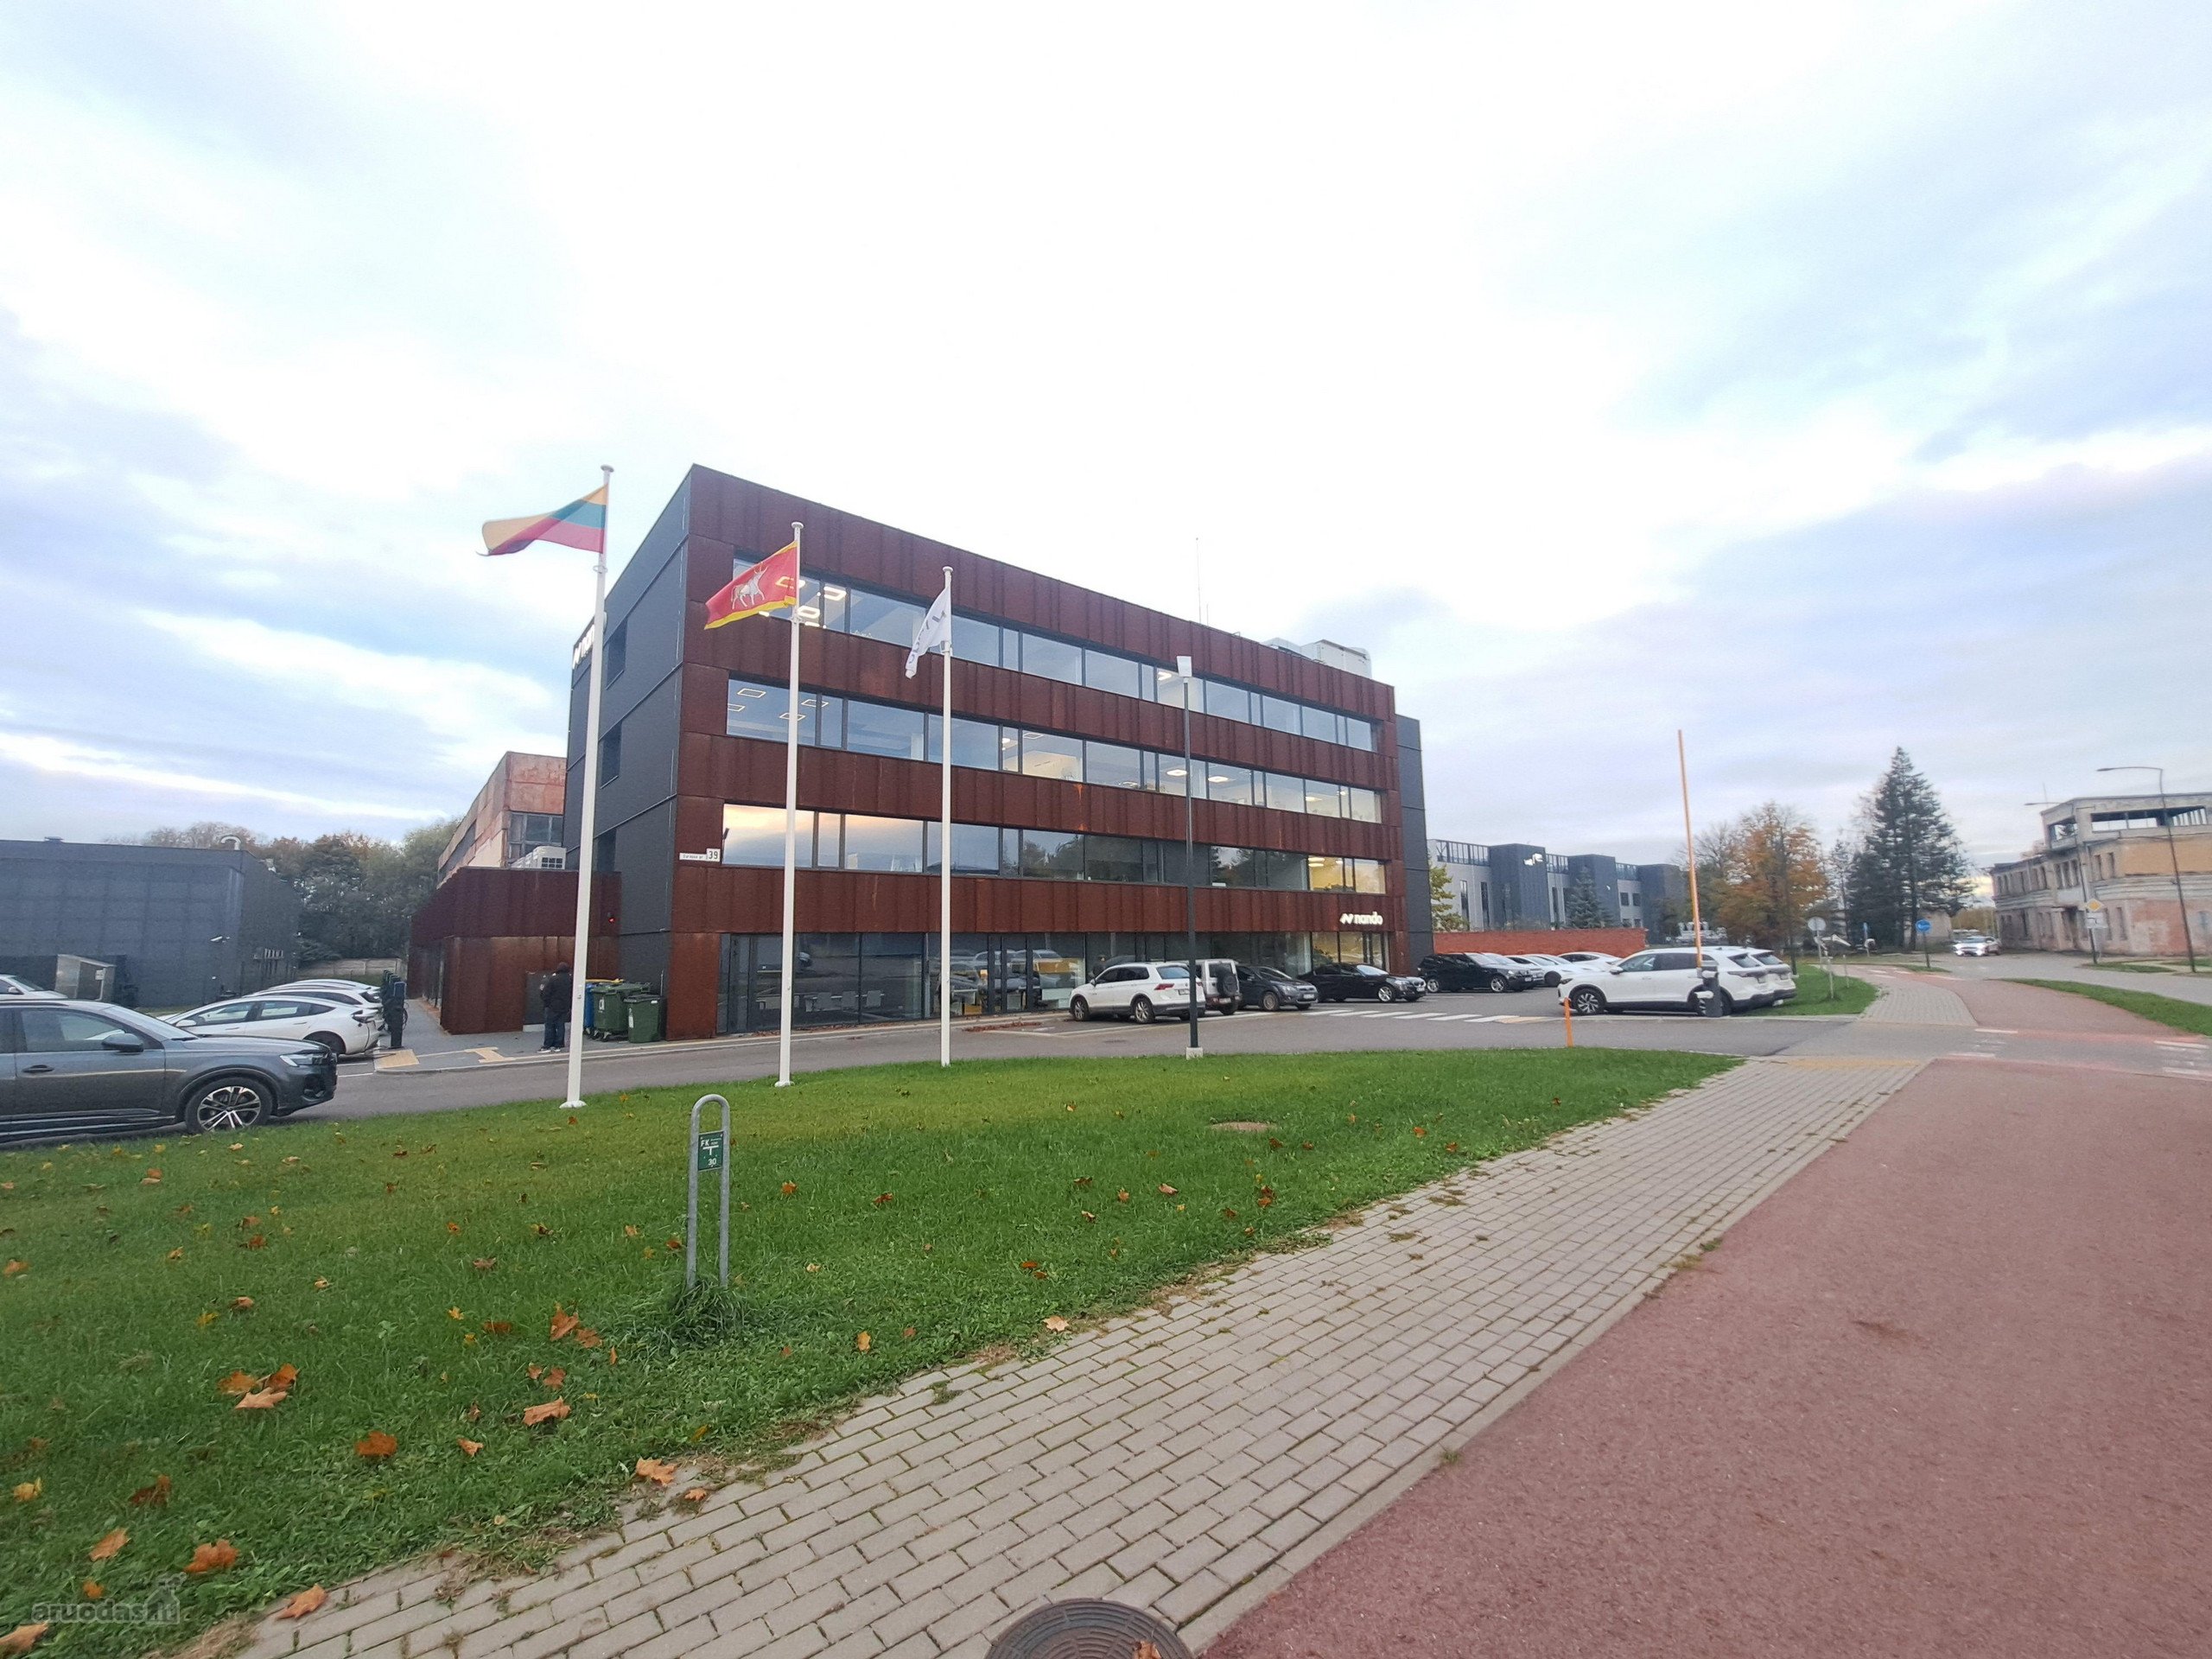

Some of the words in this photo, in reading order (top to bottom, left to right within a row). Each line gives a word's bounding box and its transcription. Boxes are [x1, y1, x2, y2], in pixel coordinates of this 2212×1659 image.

[709, 850, 719, 860] 39
[1354, 911, 1383, 925] nando
[701, 1139, 709, 1147] FK
